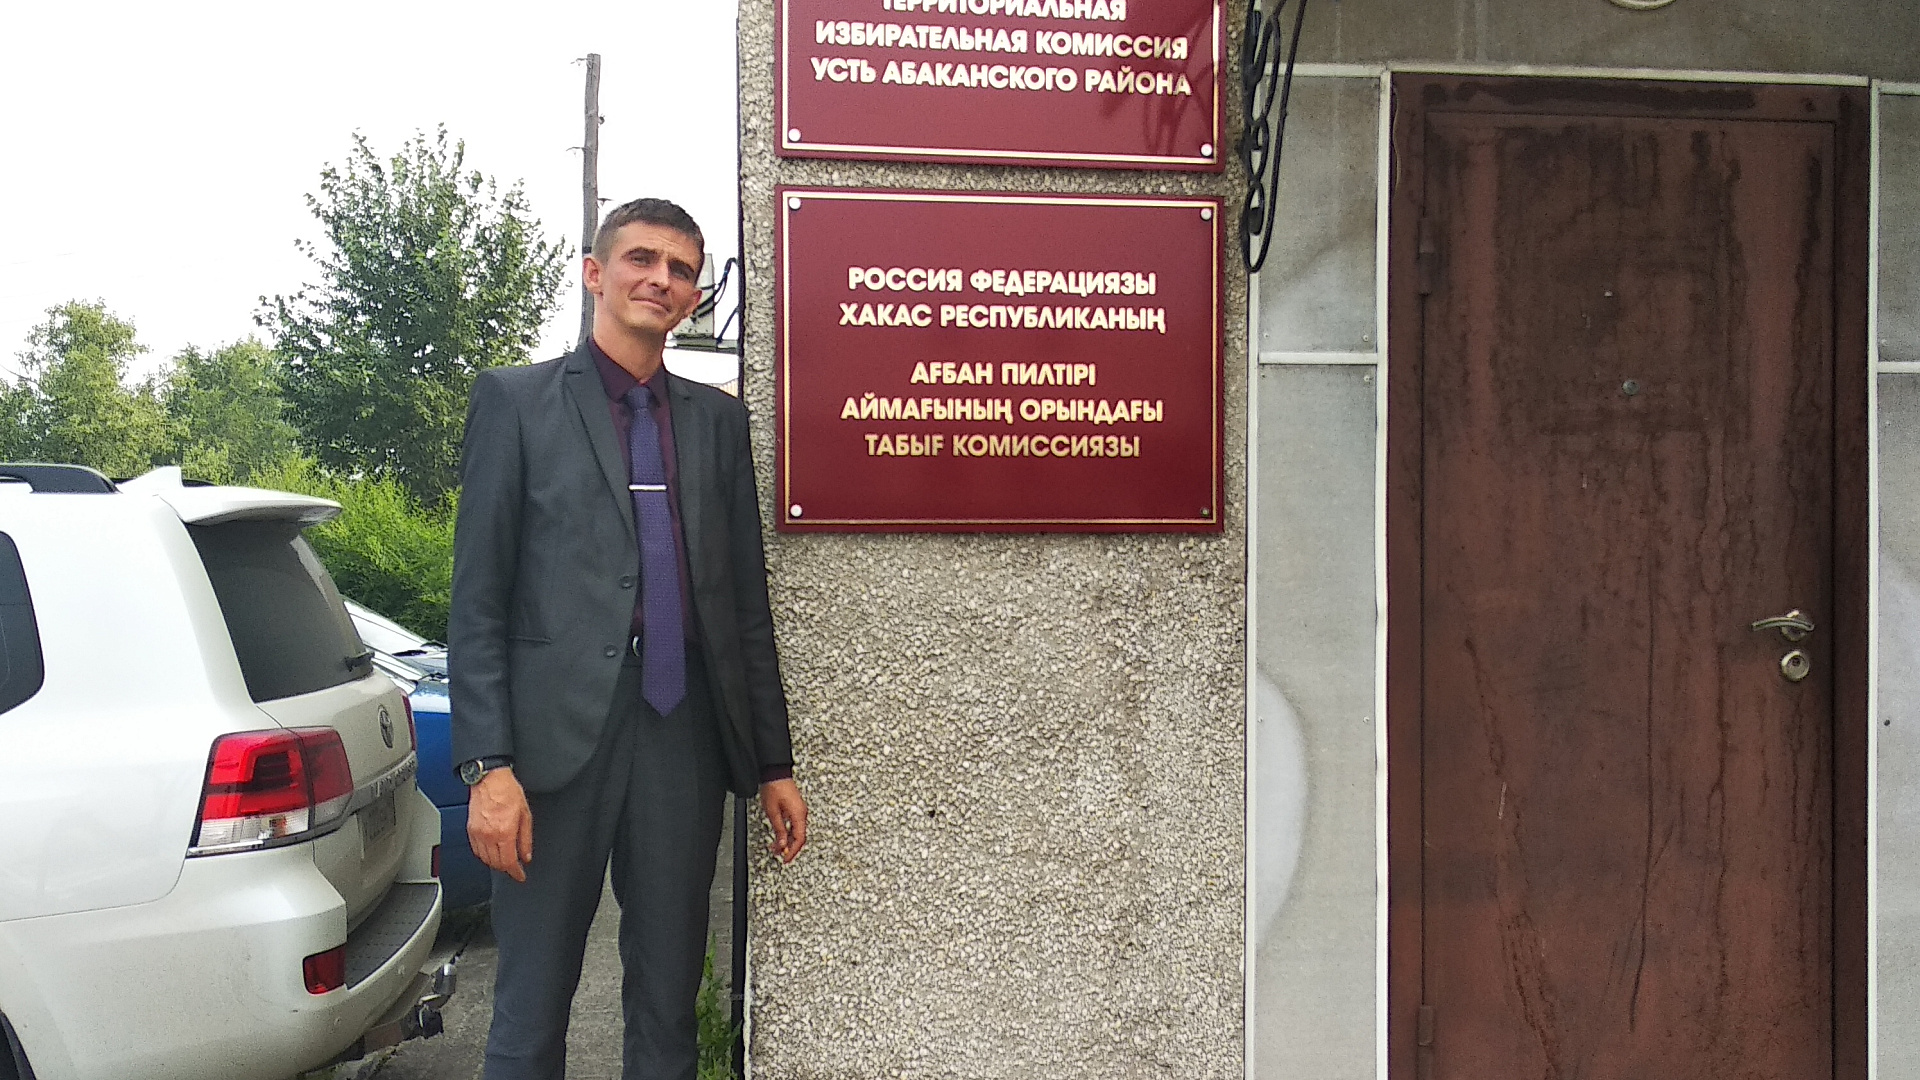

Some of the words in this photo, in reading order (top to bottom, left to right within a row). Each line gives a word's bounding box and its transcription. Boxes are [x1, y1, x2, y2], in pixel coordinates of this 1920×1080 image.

[815, 21, 1028, 54] ИЗБИРАТЕЛЬНАЯ
[1036, 31, 1188, 60] КОМИССИЯ
[811, 57, 877, 83] УСТЬ
[882, 61, 1078, 92] АБАКАНСКОГО
[1085, 66, 1192, 96] РАЙОНА
[849, 267, 963, 292] РОССИЯ
[970, 269, 1157, 298] ФЕДЕРАЦИЯЗЫ
[839, 302, 933, 327] ХАКАС
[941, 305, 1166, 334] РЕСПУБЛИКАНЫҢ
[953, 434, 1140, 457] КОМИССИЯЗЫ
